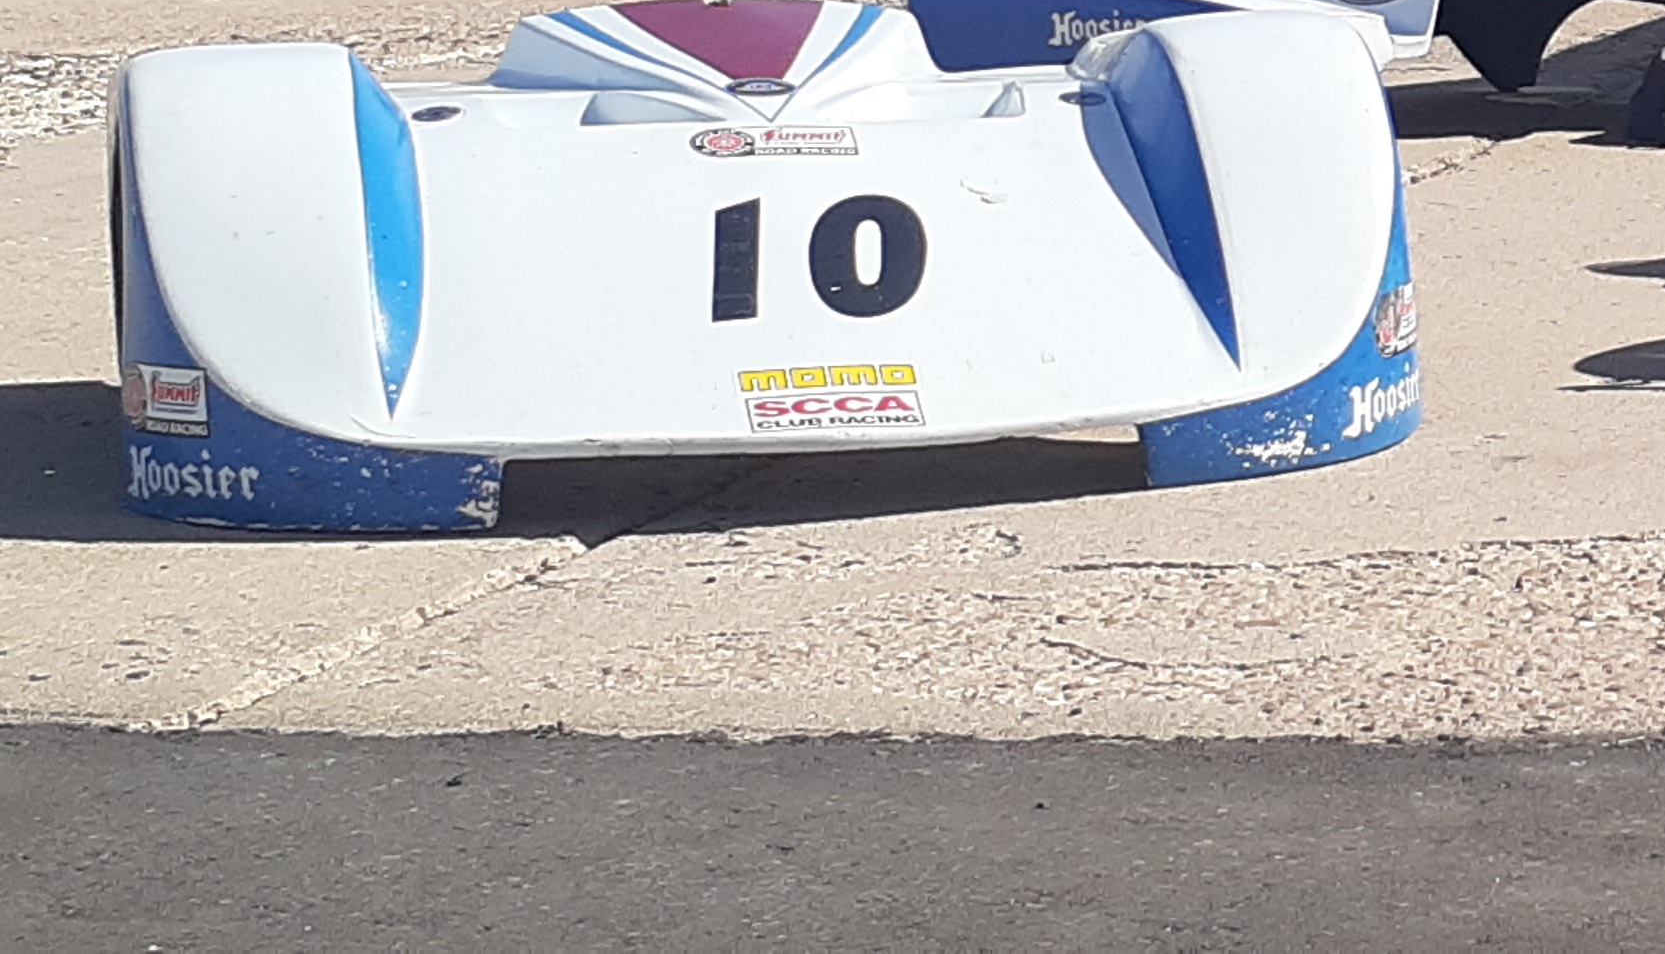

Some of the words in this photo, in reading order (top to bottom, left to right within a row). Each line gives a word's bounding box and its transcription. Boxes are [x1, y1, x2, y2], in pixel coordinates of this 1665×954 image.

[1048, 9, 1146, 47] Hoosi
[712, 195, 928, 322] 10
[753, 396, 915, 417] SCCA
[756, 418, 822, 430] CLUB
[829, 414, 920, 425] RACING
[128, 446, 260, 500] Hoosier
